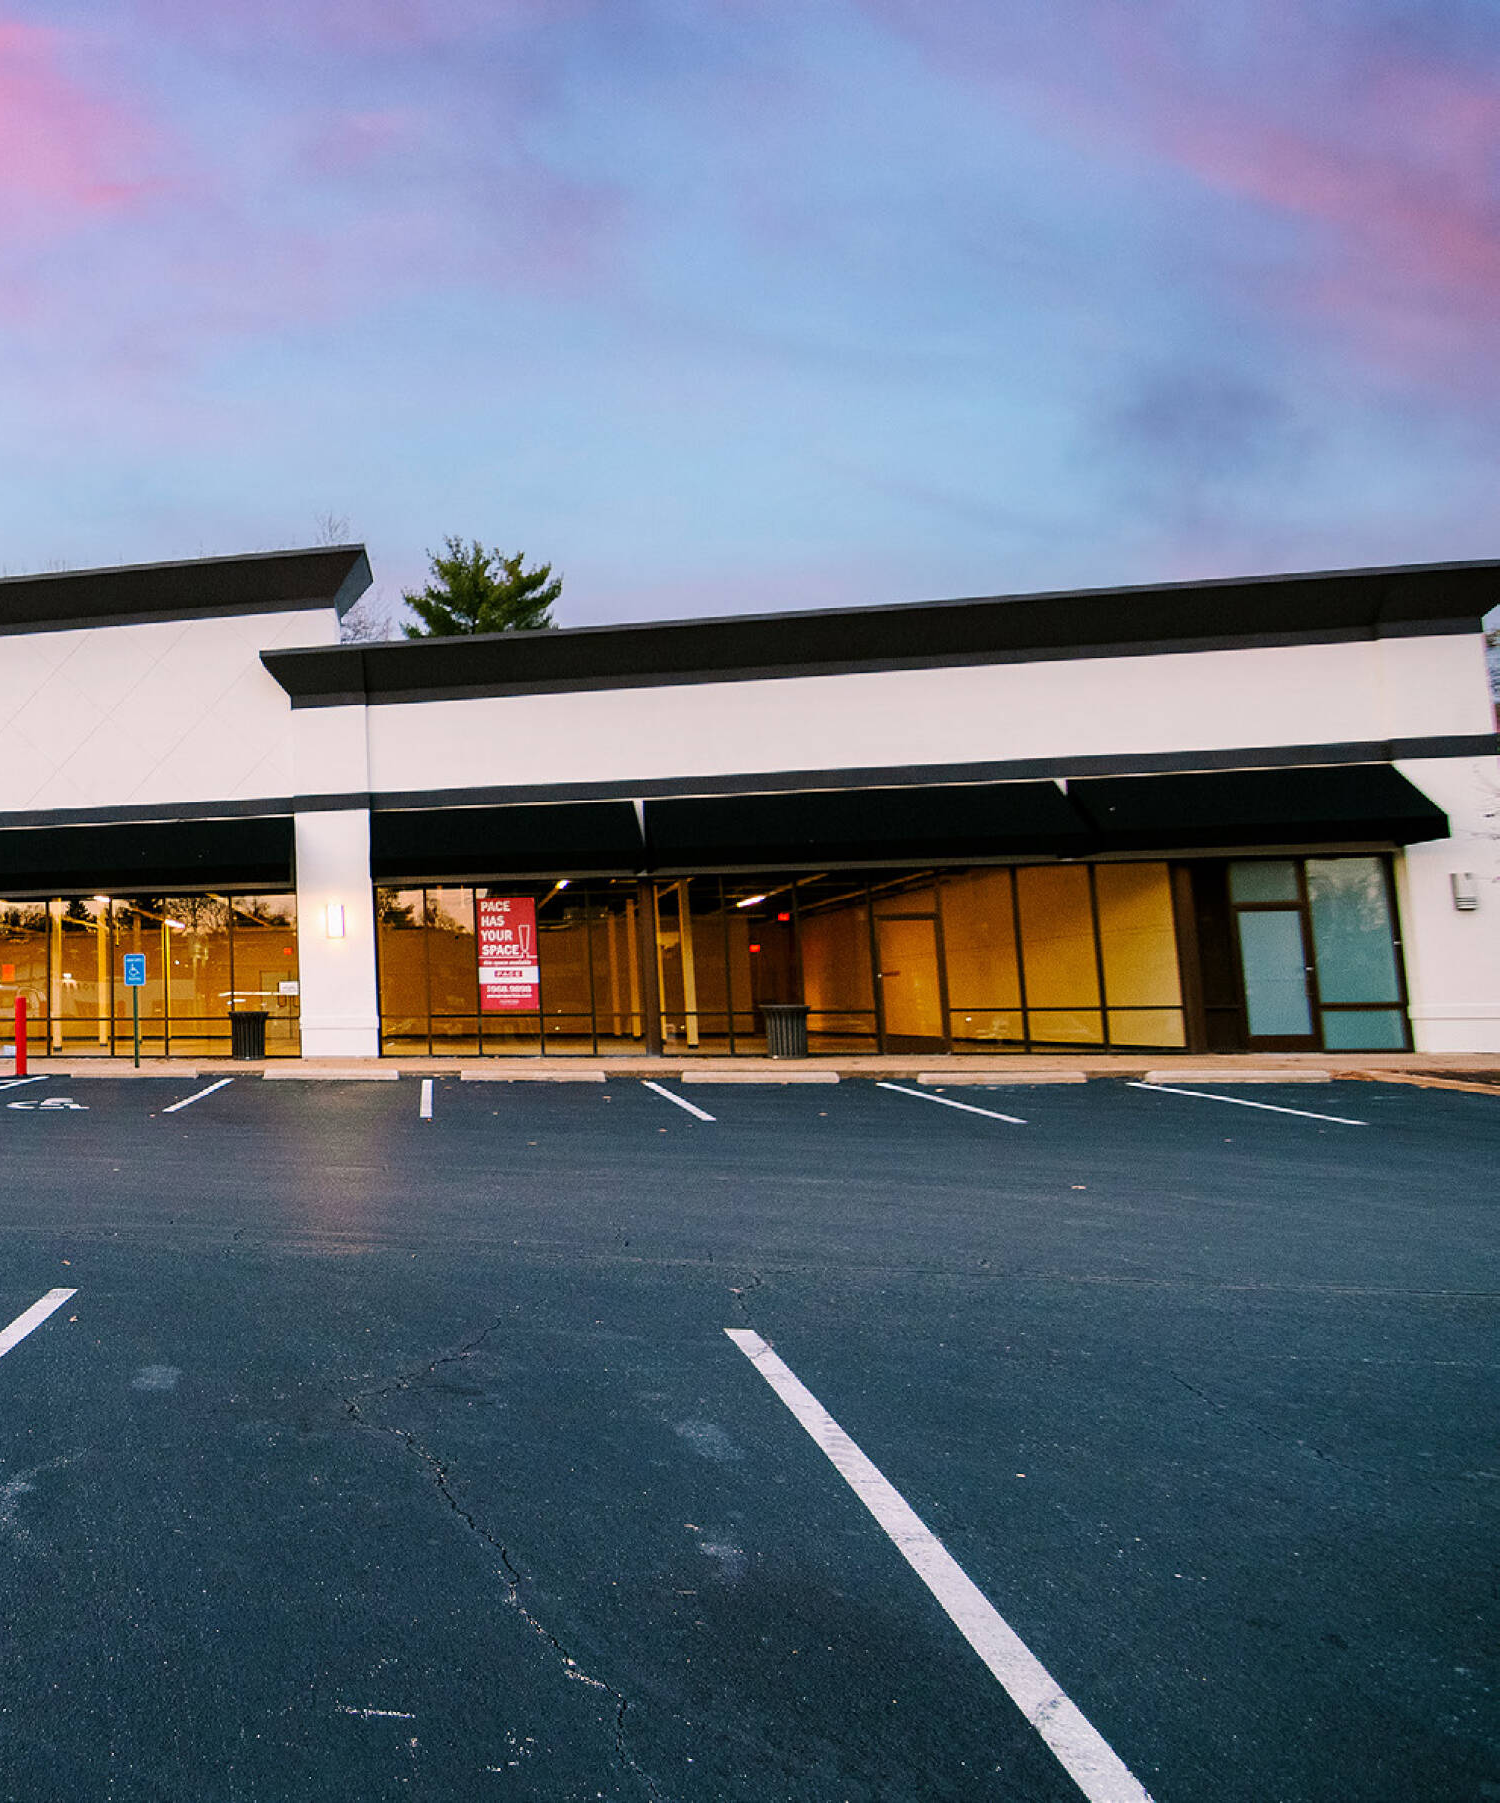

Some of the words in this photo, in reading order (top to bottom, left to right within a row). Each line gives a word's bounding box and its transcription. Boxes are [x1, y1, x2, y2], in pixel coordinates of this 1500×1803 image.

[480, 901, 511, 912] PACE
[481, 915, 505, 927] HAS
[481, 929, 513, 942] YOUR
